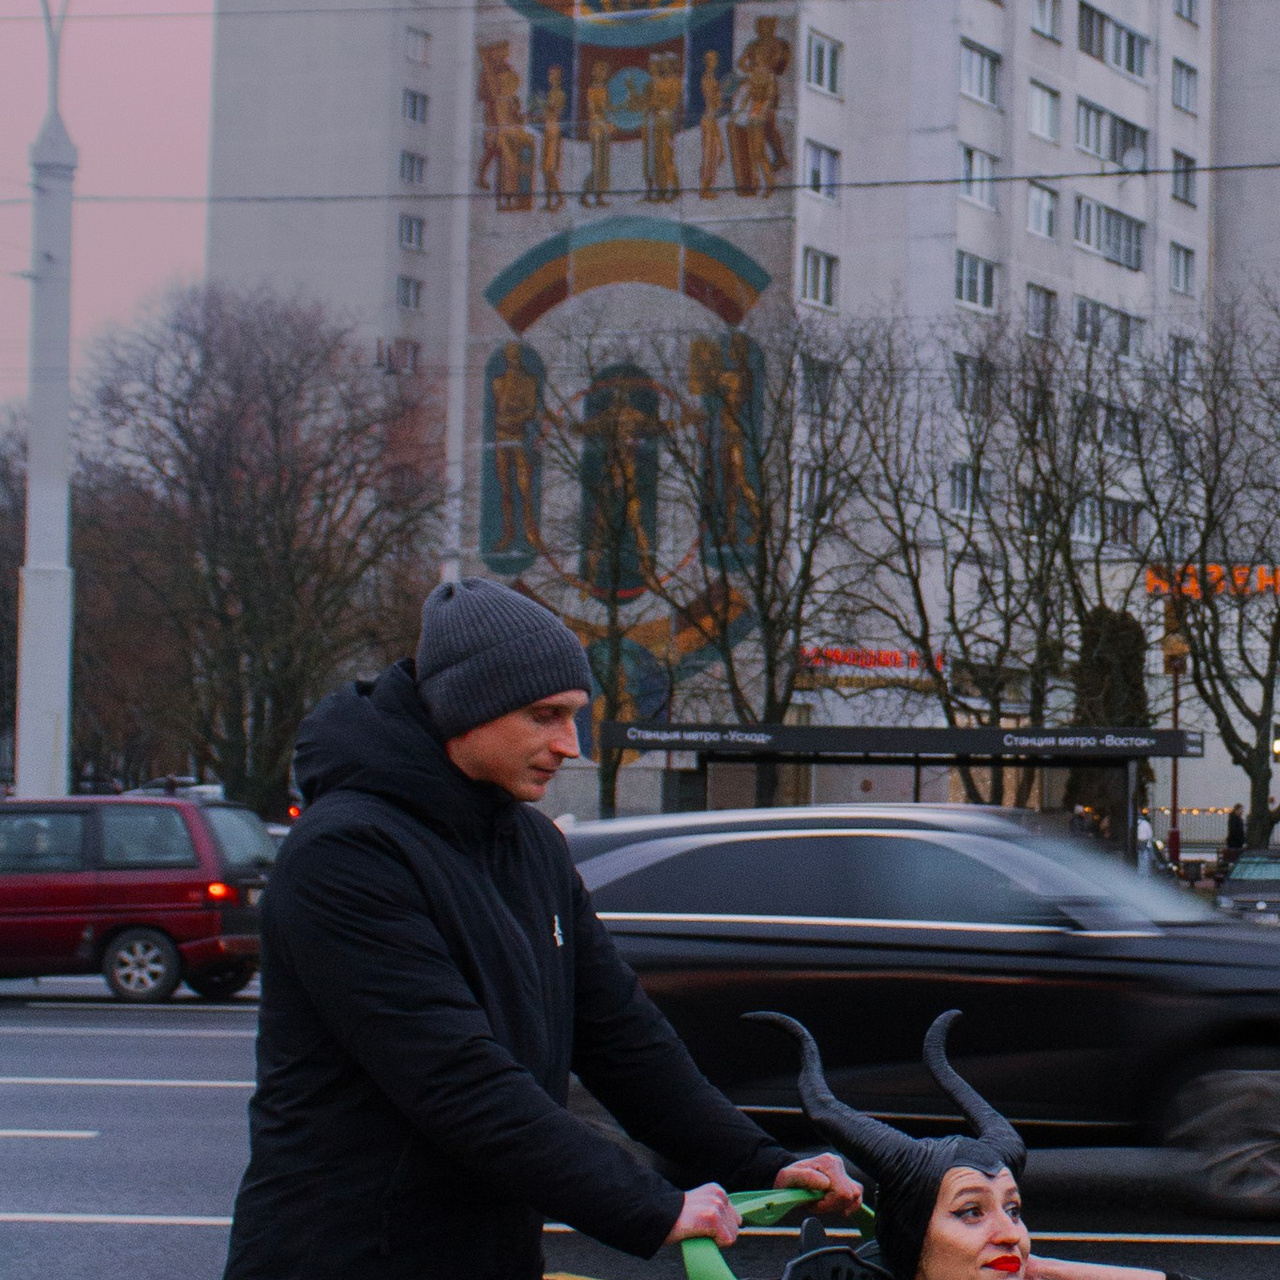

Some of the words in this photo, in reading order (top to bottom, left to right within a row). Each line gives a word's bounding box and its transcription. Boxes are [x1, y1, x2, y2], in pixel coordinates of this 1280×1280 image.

[626, 726, 681, 742] Станцыя
[683, 730, 721, 743] метро
[1003, 733, 1056, 748] Станция
[1058, 736, 1097, 749] метро
[1099, 733, 1157, 748] «Восток»
